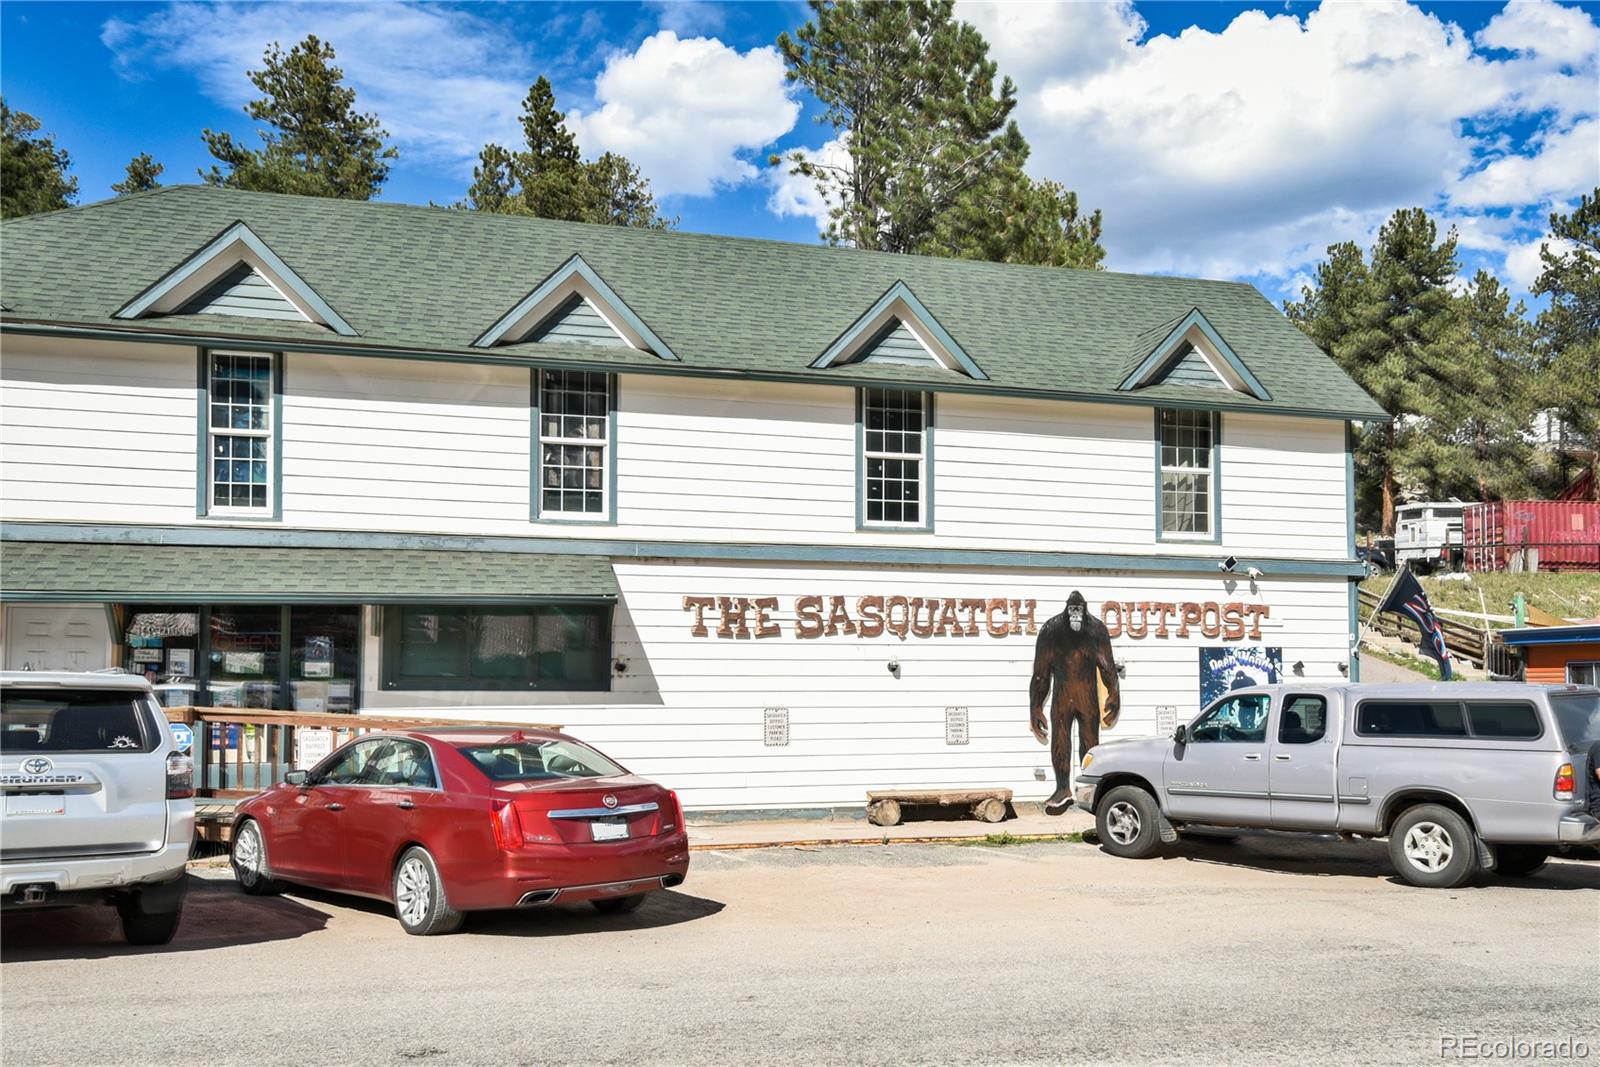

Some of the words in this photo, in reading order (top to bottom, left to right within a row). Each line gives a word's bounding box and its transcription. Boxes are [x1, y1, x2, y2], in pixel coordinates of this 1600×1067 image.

[683, 595, 781, 638] THE
[795, 595, 1038, 640] SASQUATCH
[1101, 600, 1270, 641] OUTPOST
